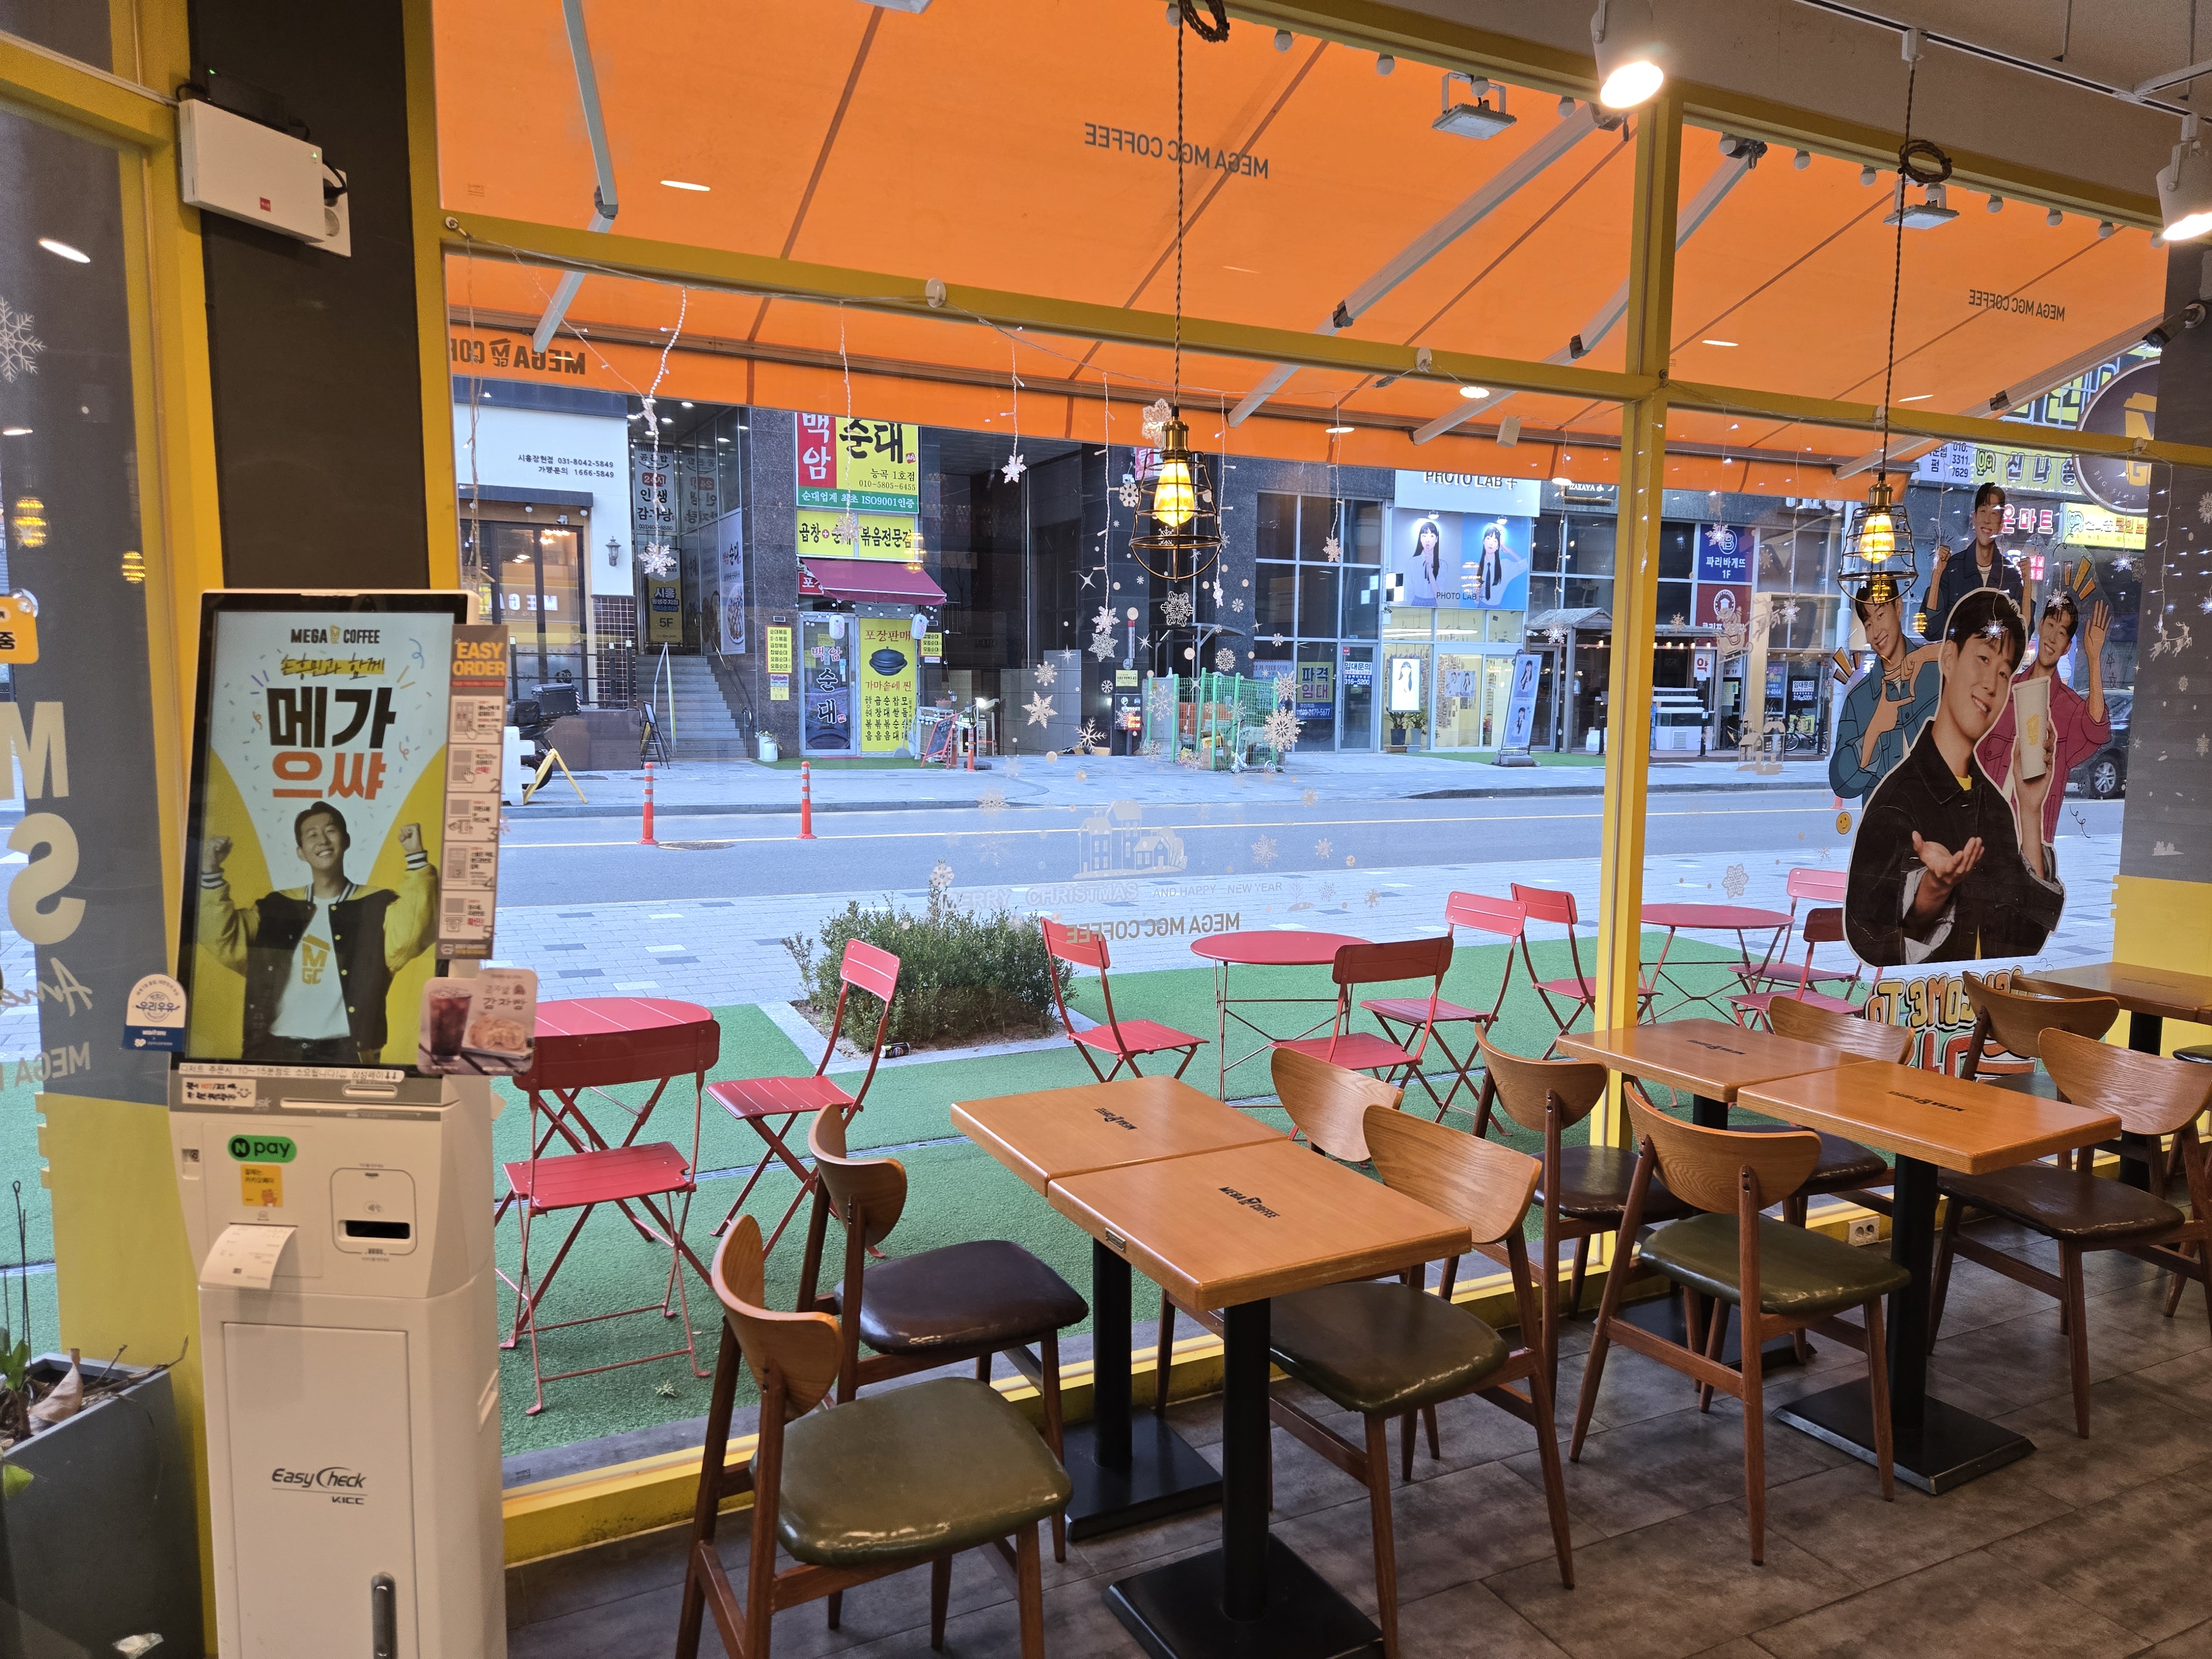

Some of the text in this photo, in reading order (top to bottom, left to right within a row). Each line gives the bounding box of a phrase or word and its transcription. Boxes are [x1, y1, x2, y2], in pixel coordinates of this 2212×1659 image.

[839, 419, 903, 464] 순대
[518, 454, 614, 468] 시흥장현점 031-8042-5849
[538, 466, 614, 478] 가맹문의 1666-5849
[870, 468, 915, 482] 능곡 1호점
[859, 480, 916, 491] 010-5805-6455
[1474, 475, 1503, 489] LAB
[1569, 483, 1595, 491] IZAKAYA
[640, 488, 667, 504] 인생
[801, 491, 837, 503] 순대업계
[862, 495, 915, 508] ISO9001인증
[799, 523, 821, 543] 곱창
[860, 526, 913, 548] 볶음전문점
[1706, 556, 1746, 568] 파리바게뜨
[1722, 570, 1731, 578] 1F
[654, 587, 676, 598] 시흥
[1436, 592, 1460, 600] PHOTO
[659, 618, 674, 628] 5F
[290, 628, 380, 644] MEGA COFFEE
[864, 630, 911, 642] 포장판매
[456, 641, 505, 660] EASY
[811, 646, 843, 662] 백암
[281, 651, 385, 681] 손흥민과 함께
[452, 660, 506, 676] ORDER
[1344, 662, 1371, 671] 임대문의
[1301, 666, 1329, 683] 파격
[865, 681, 912, 692] 가마솥에 찐
[1301, 683, 1329, 700] 임대
[816, 667, 839, 724] 순대
[266, 686, 397, 749] 메가
[272, 750, 387, 800] 으쌰
[942, 881, 1282, 911] MERRY CHRISTMAS AND HAPPY NEW YEAR
[139, 1001, 176, 1013] 우리우유
[254, 1141, 291, 1157] pay
[1218, 1187, 1281, 1218] MEGA COFFEE
